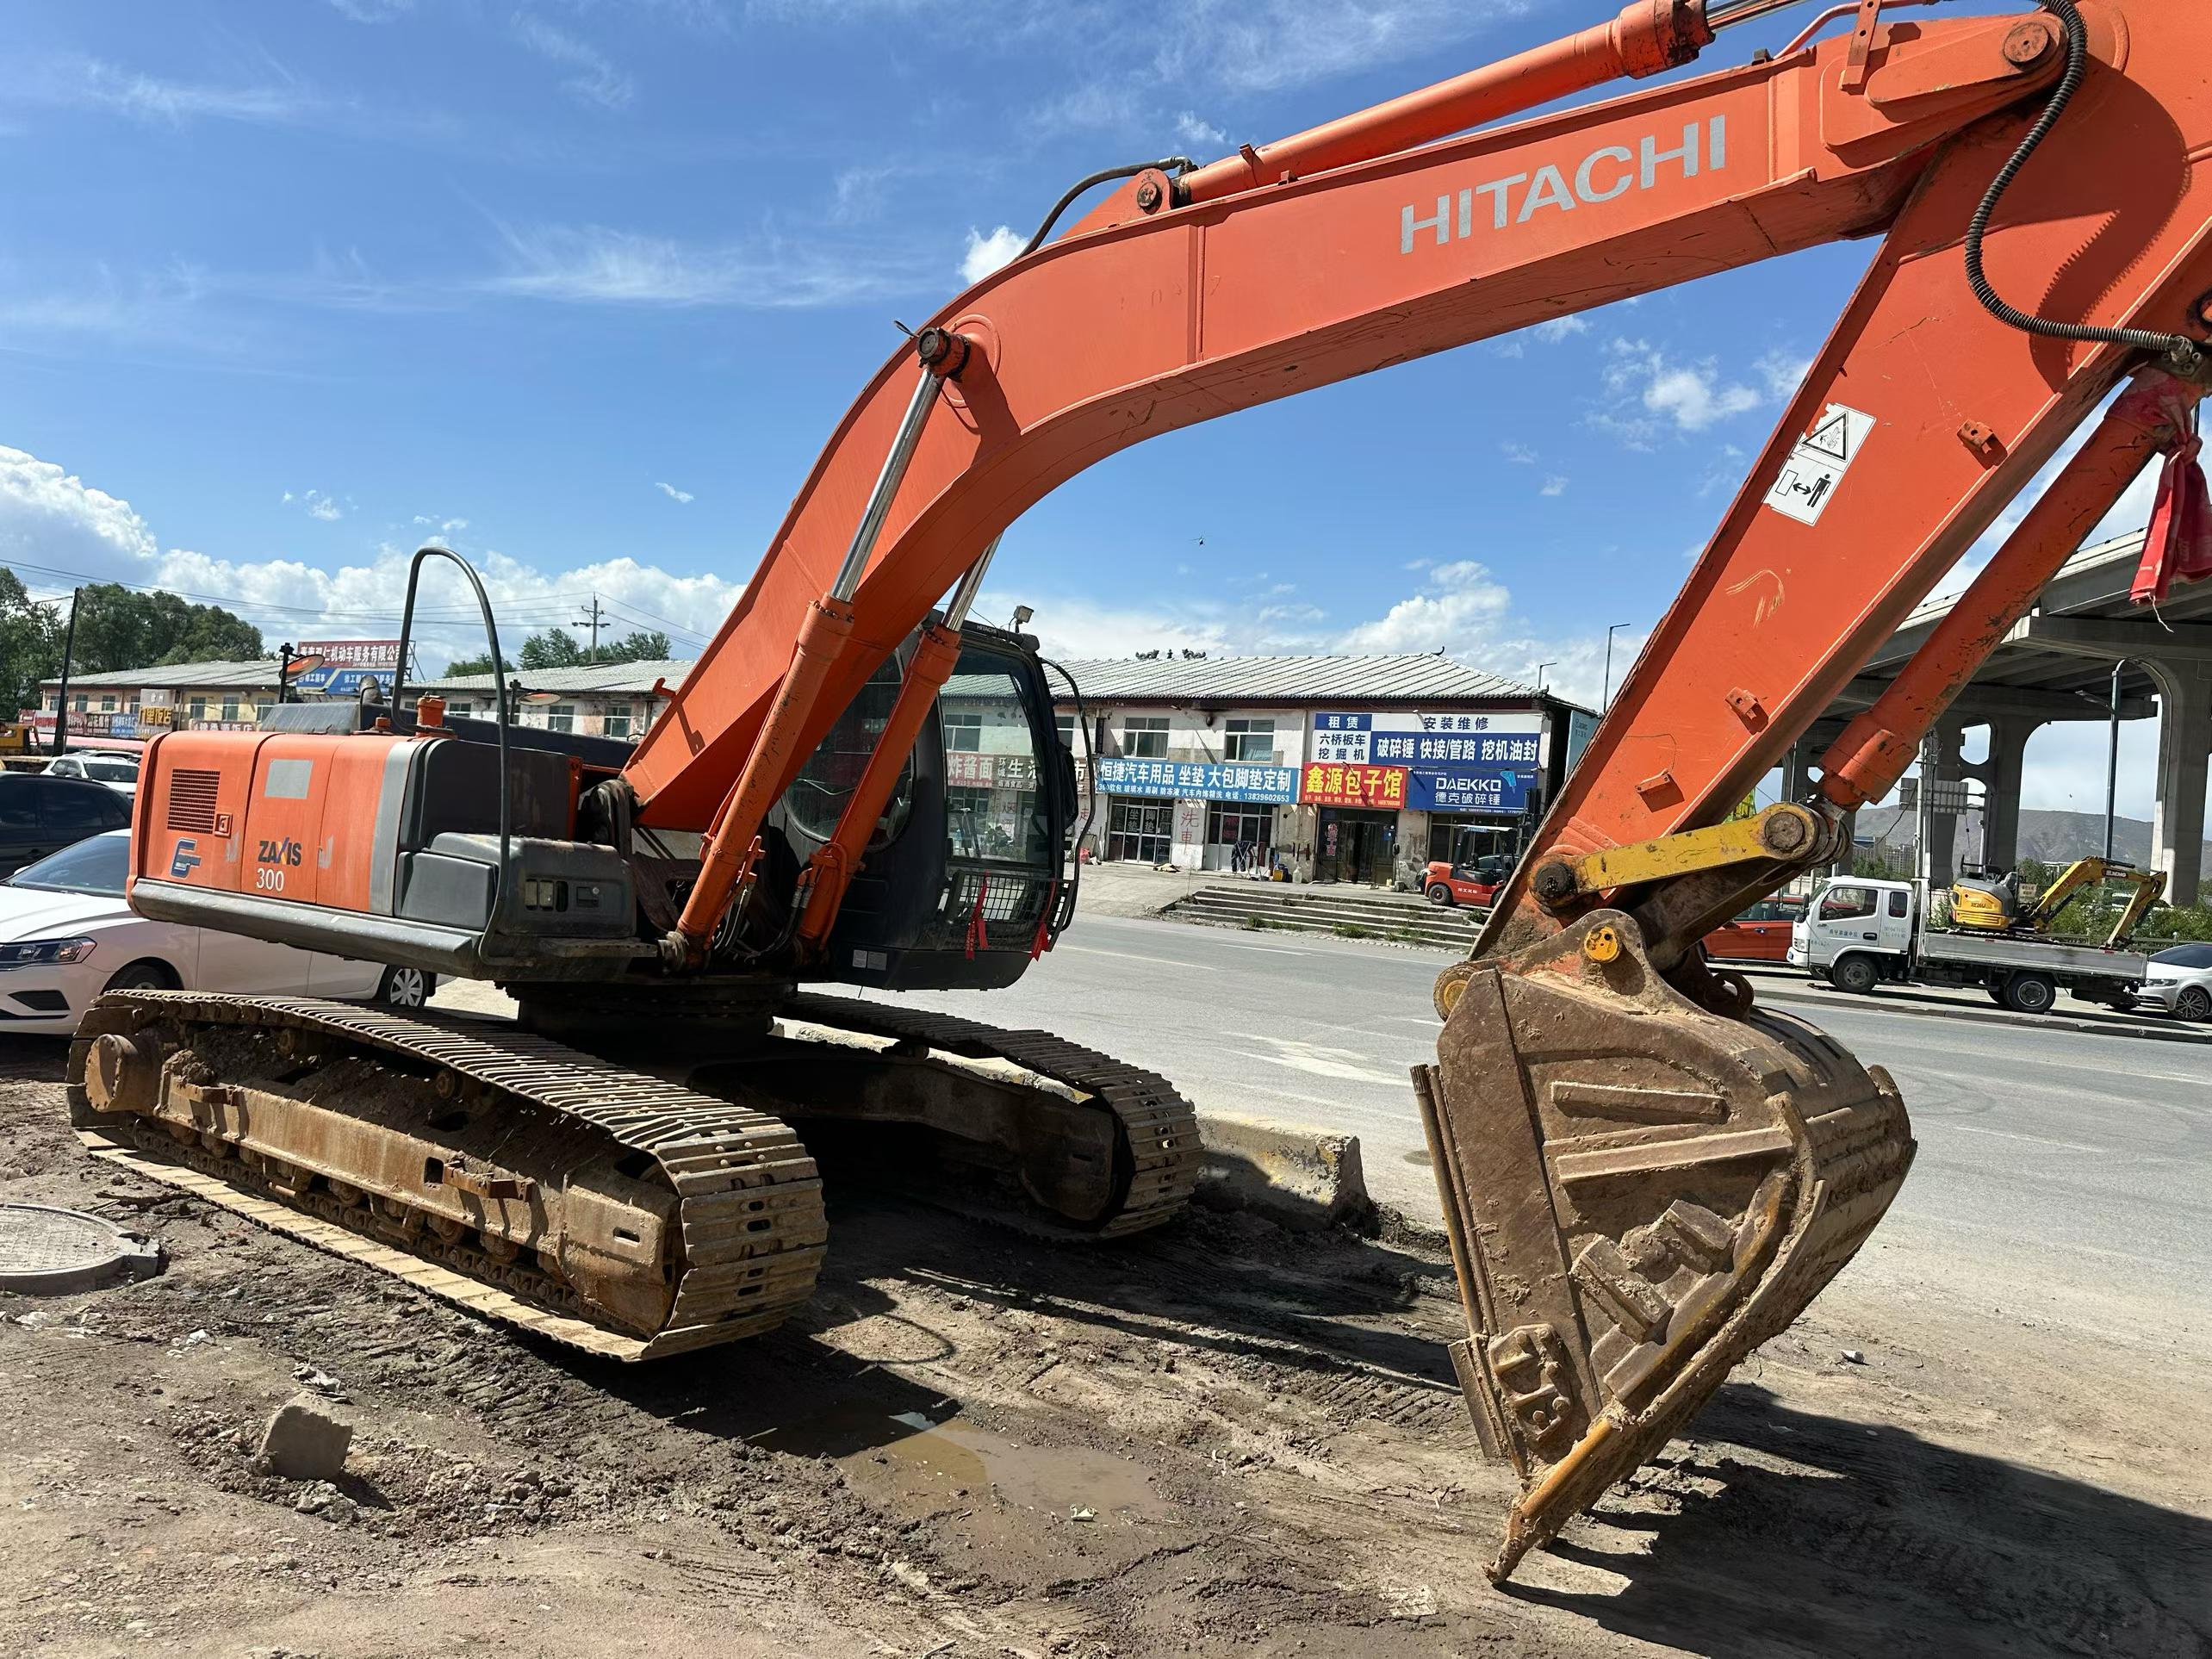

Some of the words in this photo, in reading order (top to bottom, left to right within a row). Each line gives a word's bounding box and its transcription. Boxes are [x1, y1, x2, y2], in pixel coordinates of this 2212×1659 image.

[1401, 115, 1725, 255] HITACHI
[1327, 717, 1358, 730] 租赁
[1424, 718, 1488, 730] 安装维修
[1319, 734, 1366, 747] 六桥板车
[1377, 738, 1414, 760] 破碎锤
[1420, 739, 1476, 761] 快接/管路
[1481, 740, 1538, 762] 挖机油封
[1318, 748, 1365, 761] 挖掘机
[1100, 760, 1175, 786] 恒捷汽车用品
[1177, 765, 1205, 787] 坐垫
[1207, 766, 1291, 792] 大包脚垫定制
[1306, 765, 1403, 798] 鑫源包子馆
[1435, 777, 1502, 792] DAEKKO
[1435, 791, 1501, 805] 德克破碎锤
[258, 836, 301, 867] ZAXIS
[256, 867, 285, 892] 300
